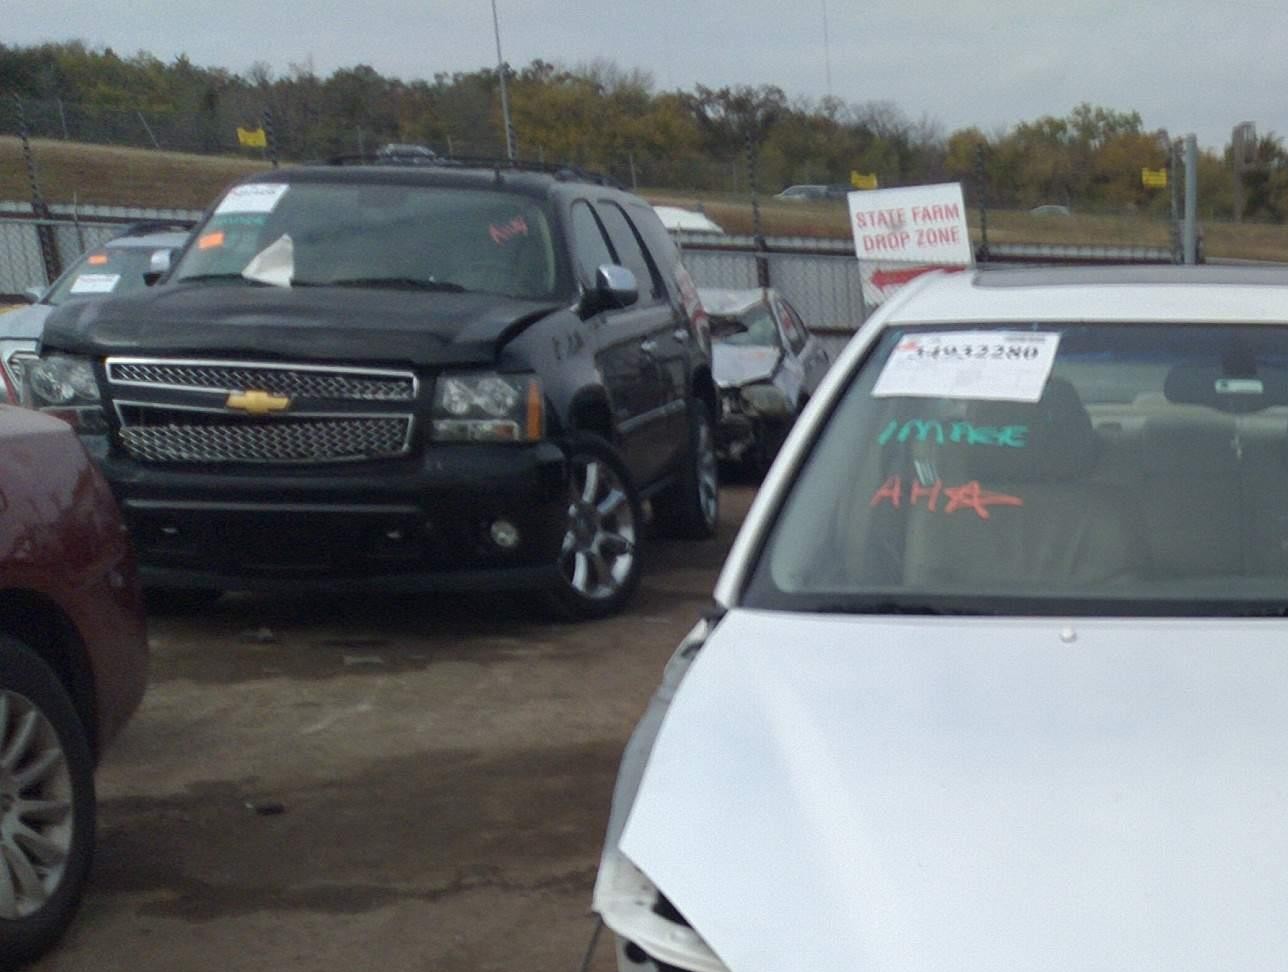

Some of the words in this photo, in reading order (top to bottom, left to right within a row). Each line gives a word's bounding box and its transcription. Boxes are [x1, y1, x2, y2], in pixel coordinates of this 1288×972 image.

[856, 208, 906, 229] STATE
[912, 203, 960, 224] FARM
[863, 231, 911, 252] DROP
[915, 226, 961, 248] ZONE
